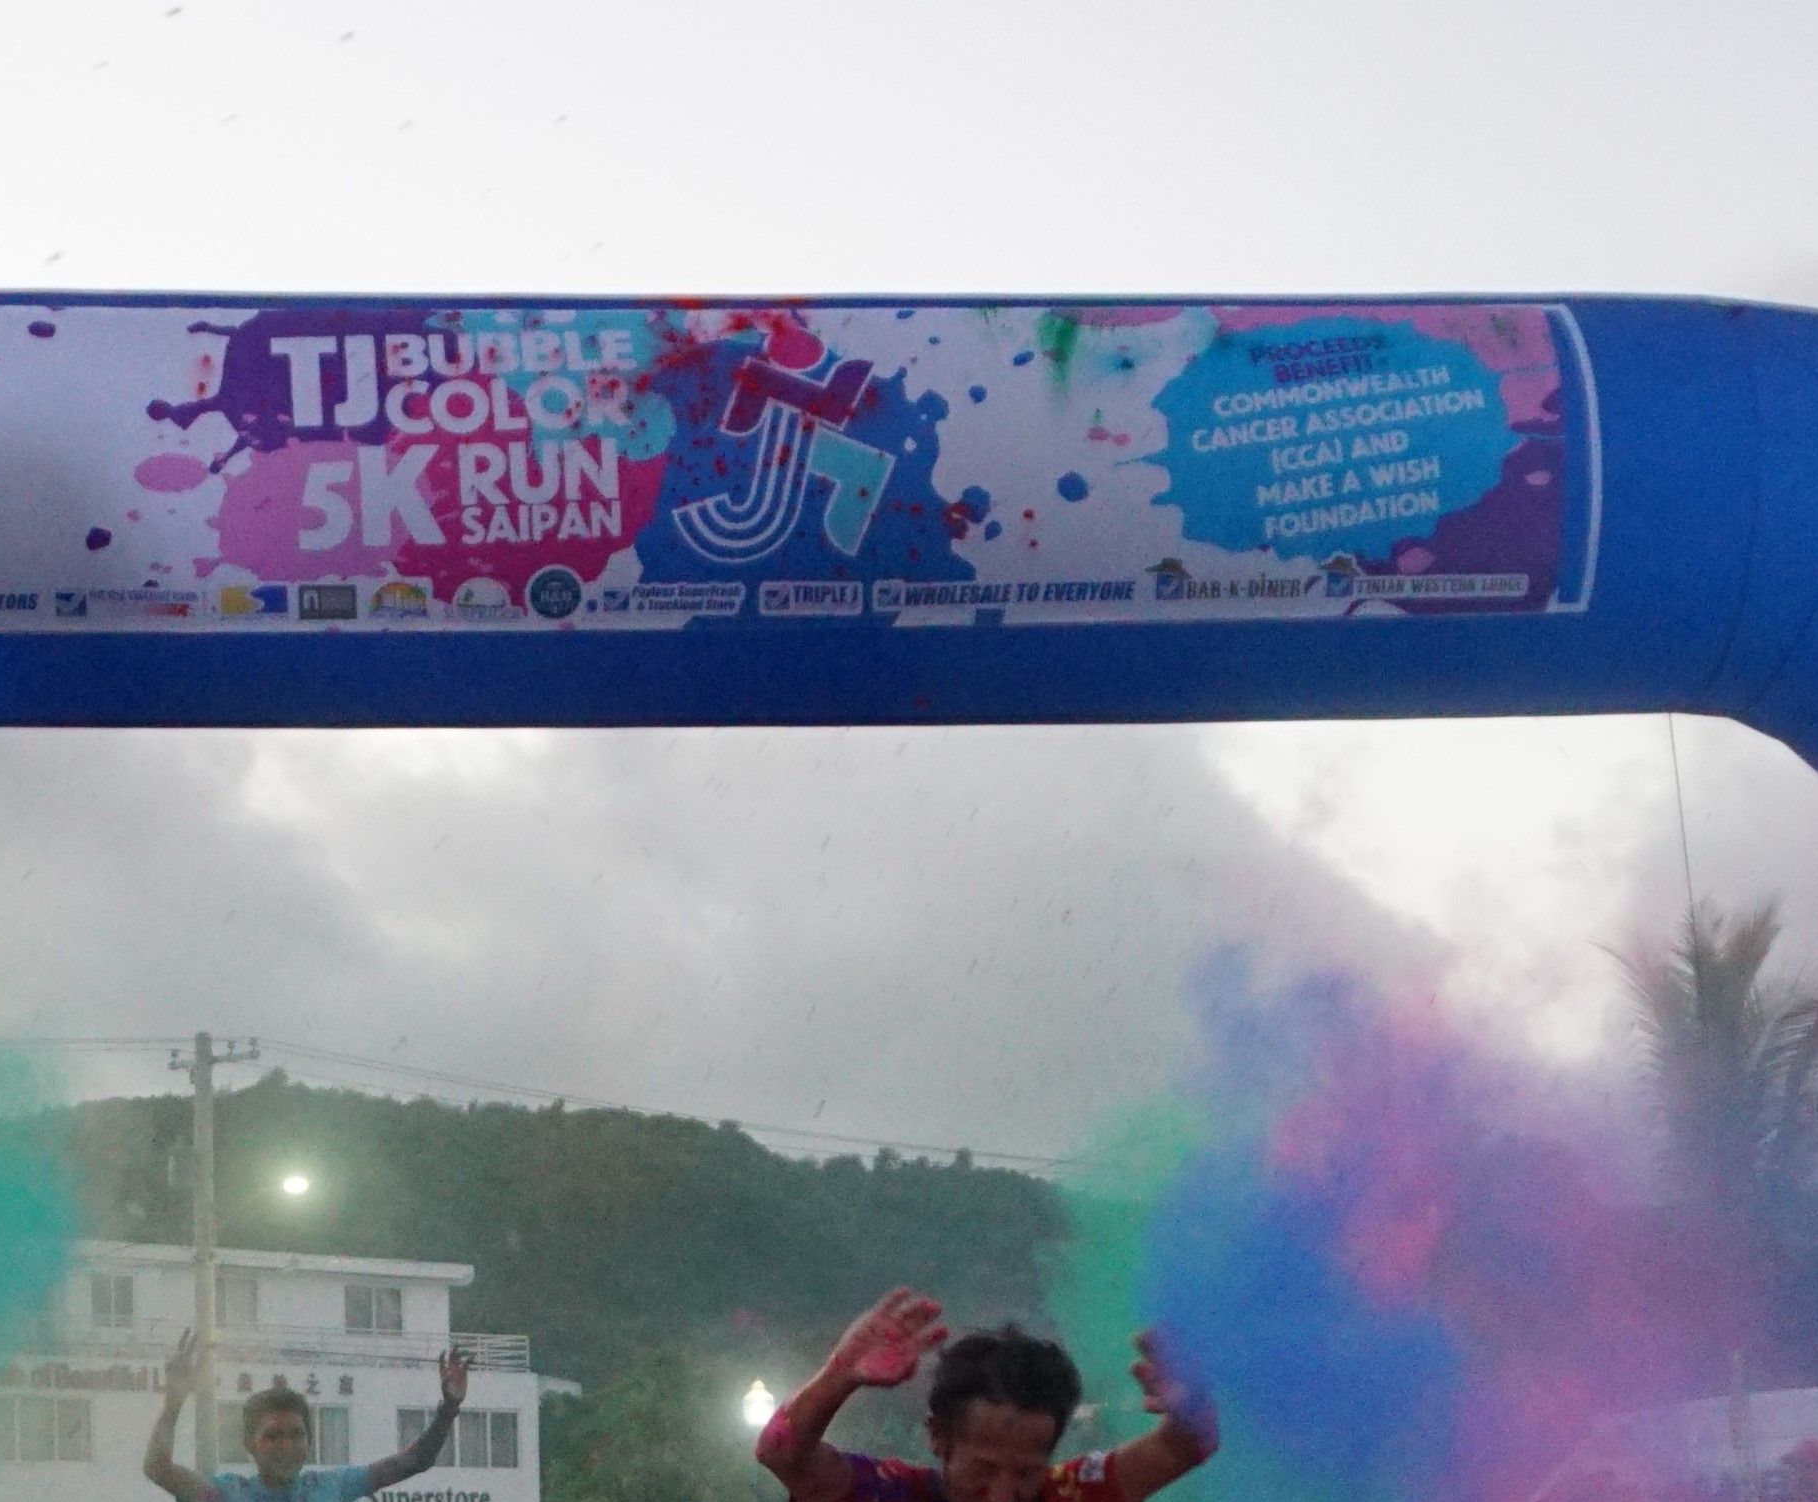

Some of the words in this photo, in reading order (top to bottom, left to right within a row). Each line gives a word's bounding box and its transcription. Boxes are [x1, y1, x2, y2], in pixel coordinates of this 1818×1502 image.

[385, 329, 638, 377] BUBBLE
[1273, 354, 1372, 384] BENEFIT
[269, 334, 380, 428] TJ
[384, 375, 635, 434] COLOR
[1213, 366, 1452, 418] COMMONWEALTH
[1191, 416, 1301, 452] CANCER
[1306, 389, 1486, 436] ASSOCIATION
[457, 438, 622, 506] RUN
[1271, 437, 1344, 475] (CCA)
[1351, 430, 1410, 460] AND
[298, 443, 448, 552] 5K
[1256, 474, 1335, 507] MAKE
[1342, 470, 1362, 494] A
[1368, 456, 1442, 489] WISH
[460, 500, 624, 546] SAIPAN
[1264, 491, 1440, 539] FOUNDATION
[793, 584, 846, 603] TRIPLE
[903, 583, 1012, 605] WHOLESALE
[1016, 583, 1041, 603] TO
[1043, 580, 1135, 602] EVERYONE
